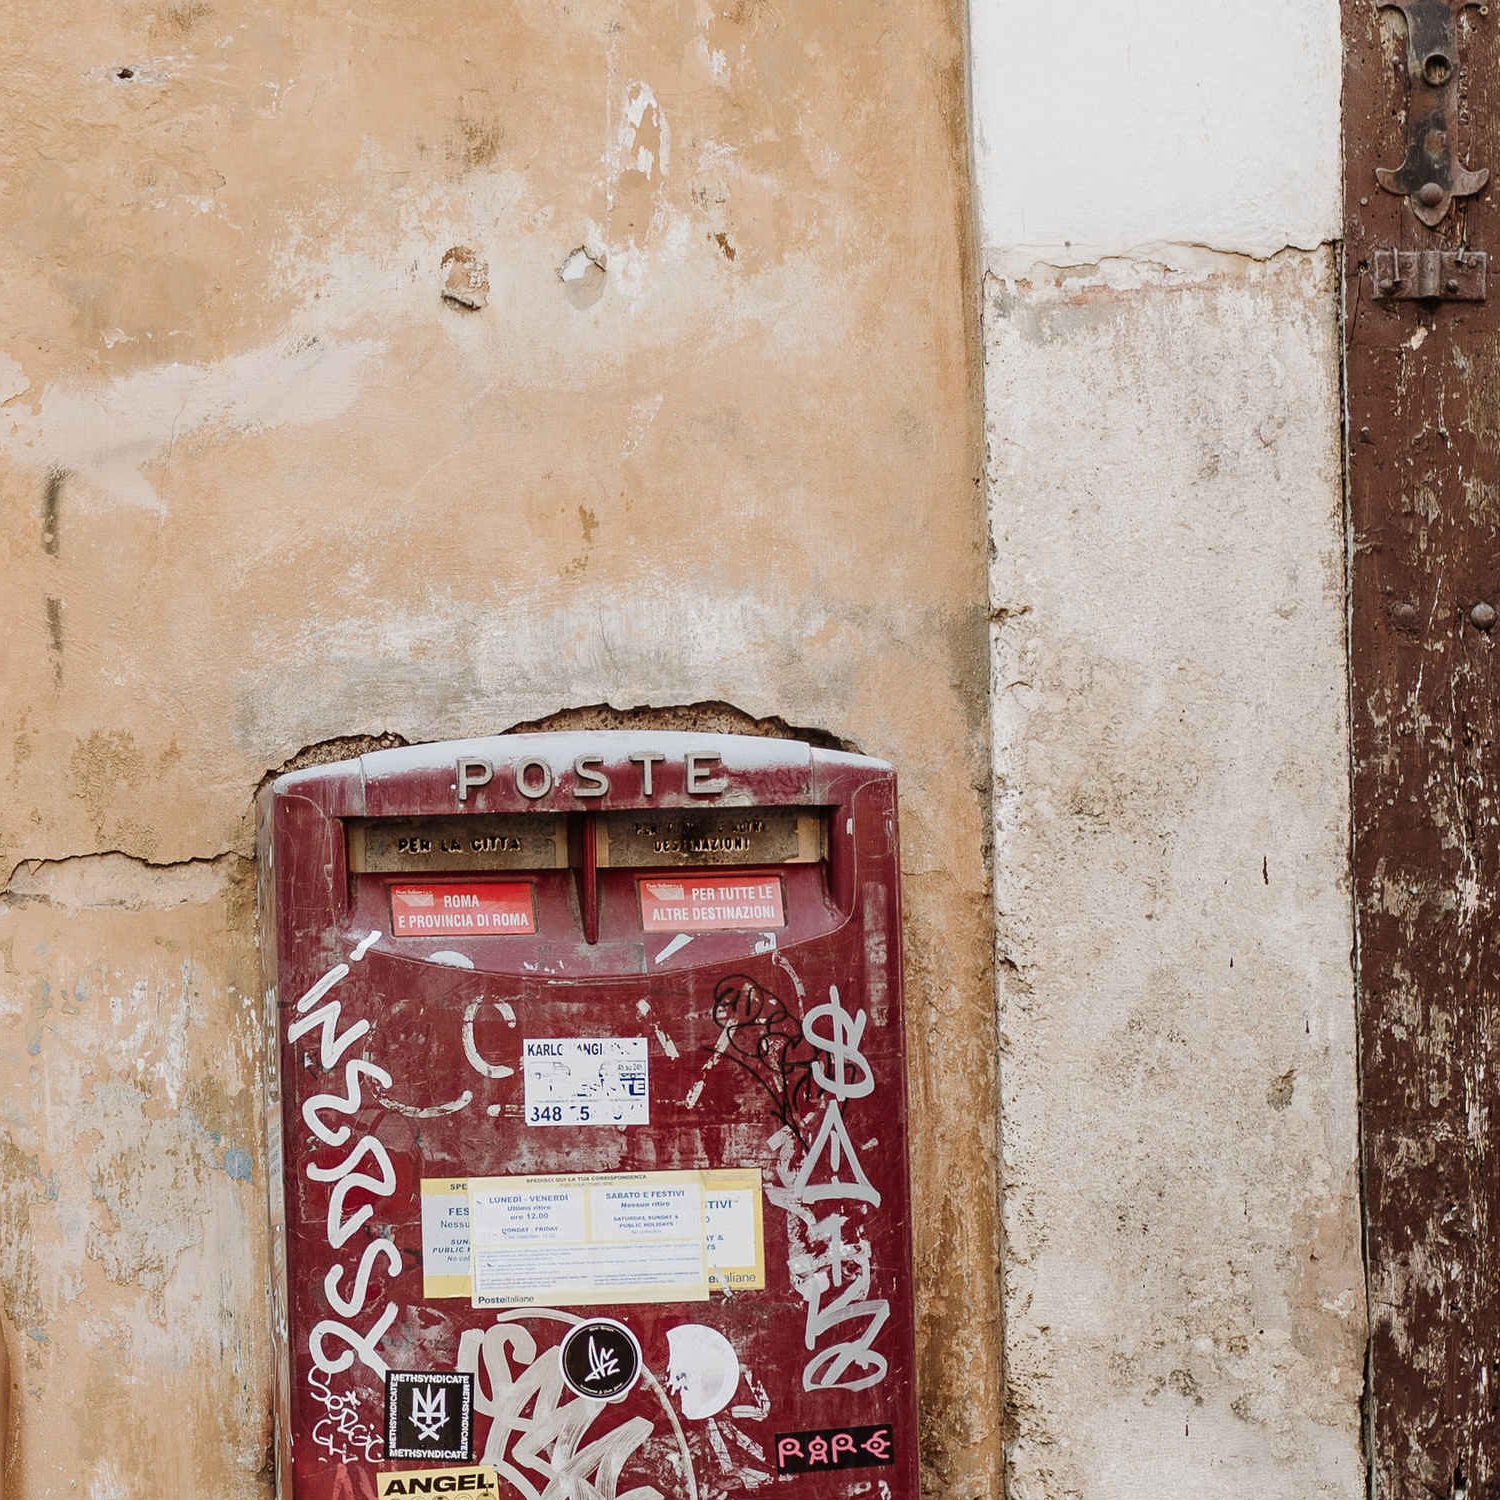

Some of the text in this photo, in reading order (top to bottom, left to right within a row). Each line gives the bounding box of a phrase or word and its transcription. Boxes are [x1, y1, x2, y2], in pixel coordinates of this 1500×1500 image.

[456, 752, 728, 801] POSTE
[398, 837, 432, 854] PER
[440, 837, 462, 854] LA
[653, 837, 750, 854] DESNAZIONI
[443, 894, 480, 908] ROMA
[692, 886, 773, 901] PER TUTTE LE
[398, 912, 529, 928] E PROVINCIA DI ROMA
[652, 906, 775, 922] ALTRE DESTINAZIONI
[530, 1106, 562, 1122] 348
[489, 1194, 522, 1204] LUNEDÌ
[530, 1194, 568, 1202] VENERDÌ
[606, 1192, 640, 1200] SABATO
[650, 1190, 684, 1198] FESTIVI
[507, 1204, 532, 1212] Ultimo
[704, 1200, 732, 1209] TIVI
[526, 1212, 549, 1220] 12.00
[451, 1238, 470, 1246] SUN
[390, 1373, 470, 1384] METHSYNDICATE
[388, 1380, 398, 1449] METHSYNDICATE
[460, 1382, 470, 1453] METHSYNDICATE
[388, 1448, 468, 1460] METHSYNDICATE
[383, 1473, 495, 1496] ANGEL
